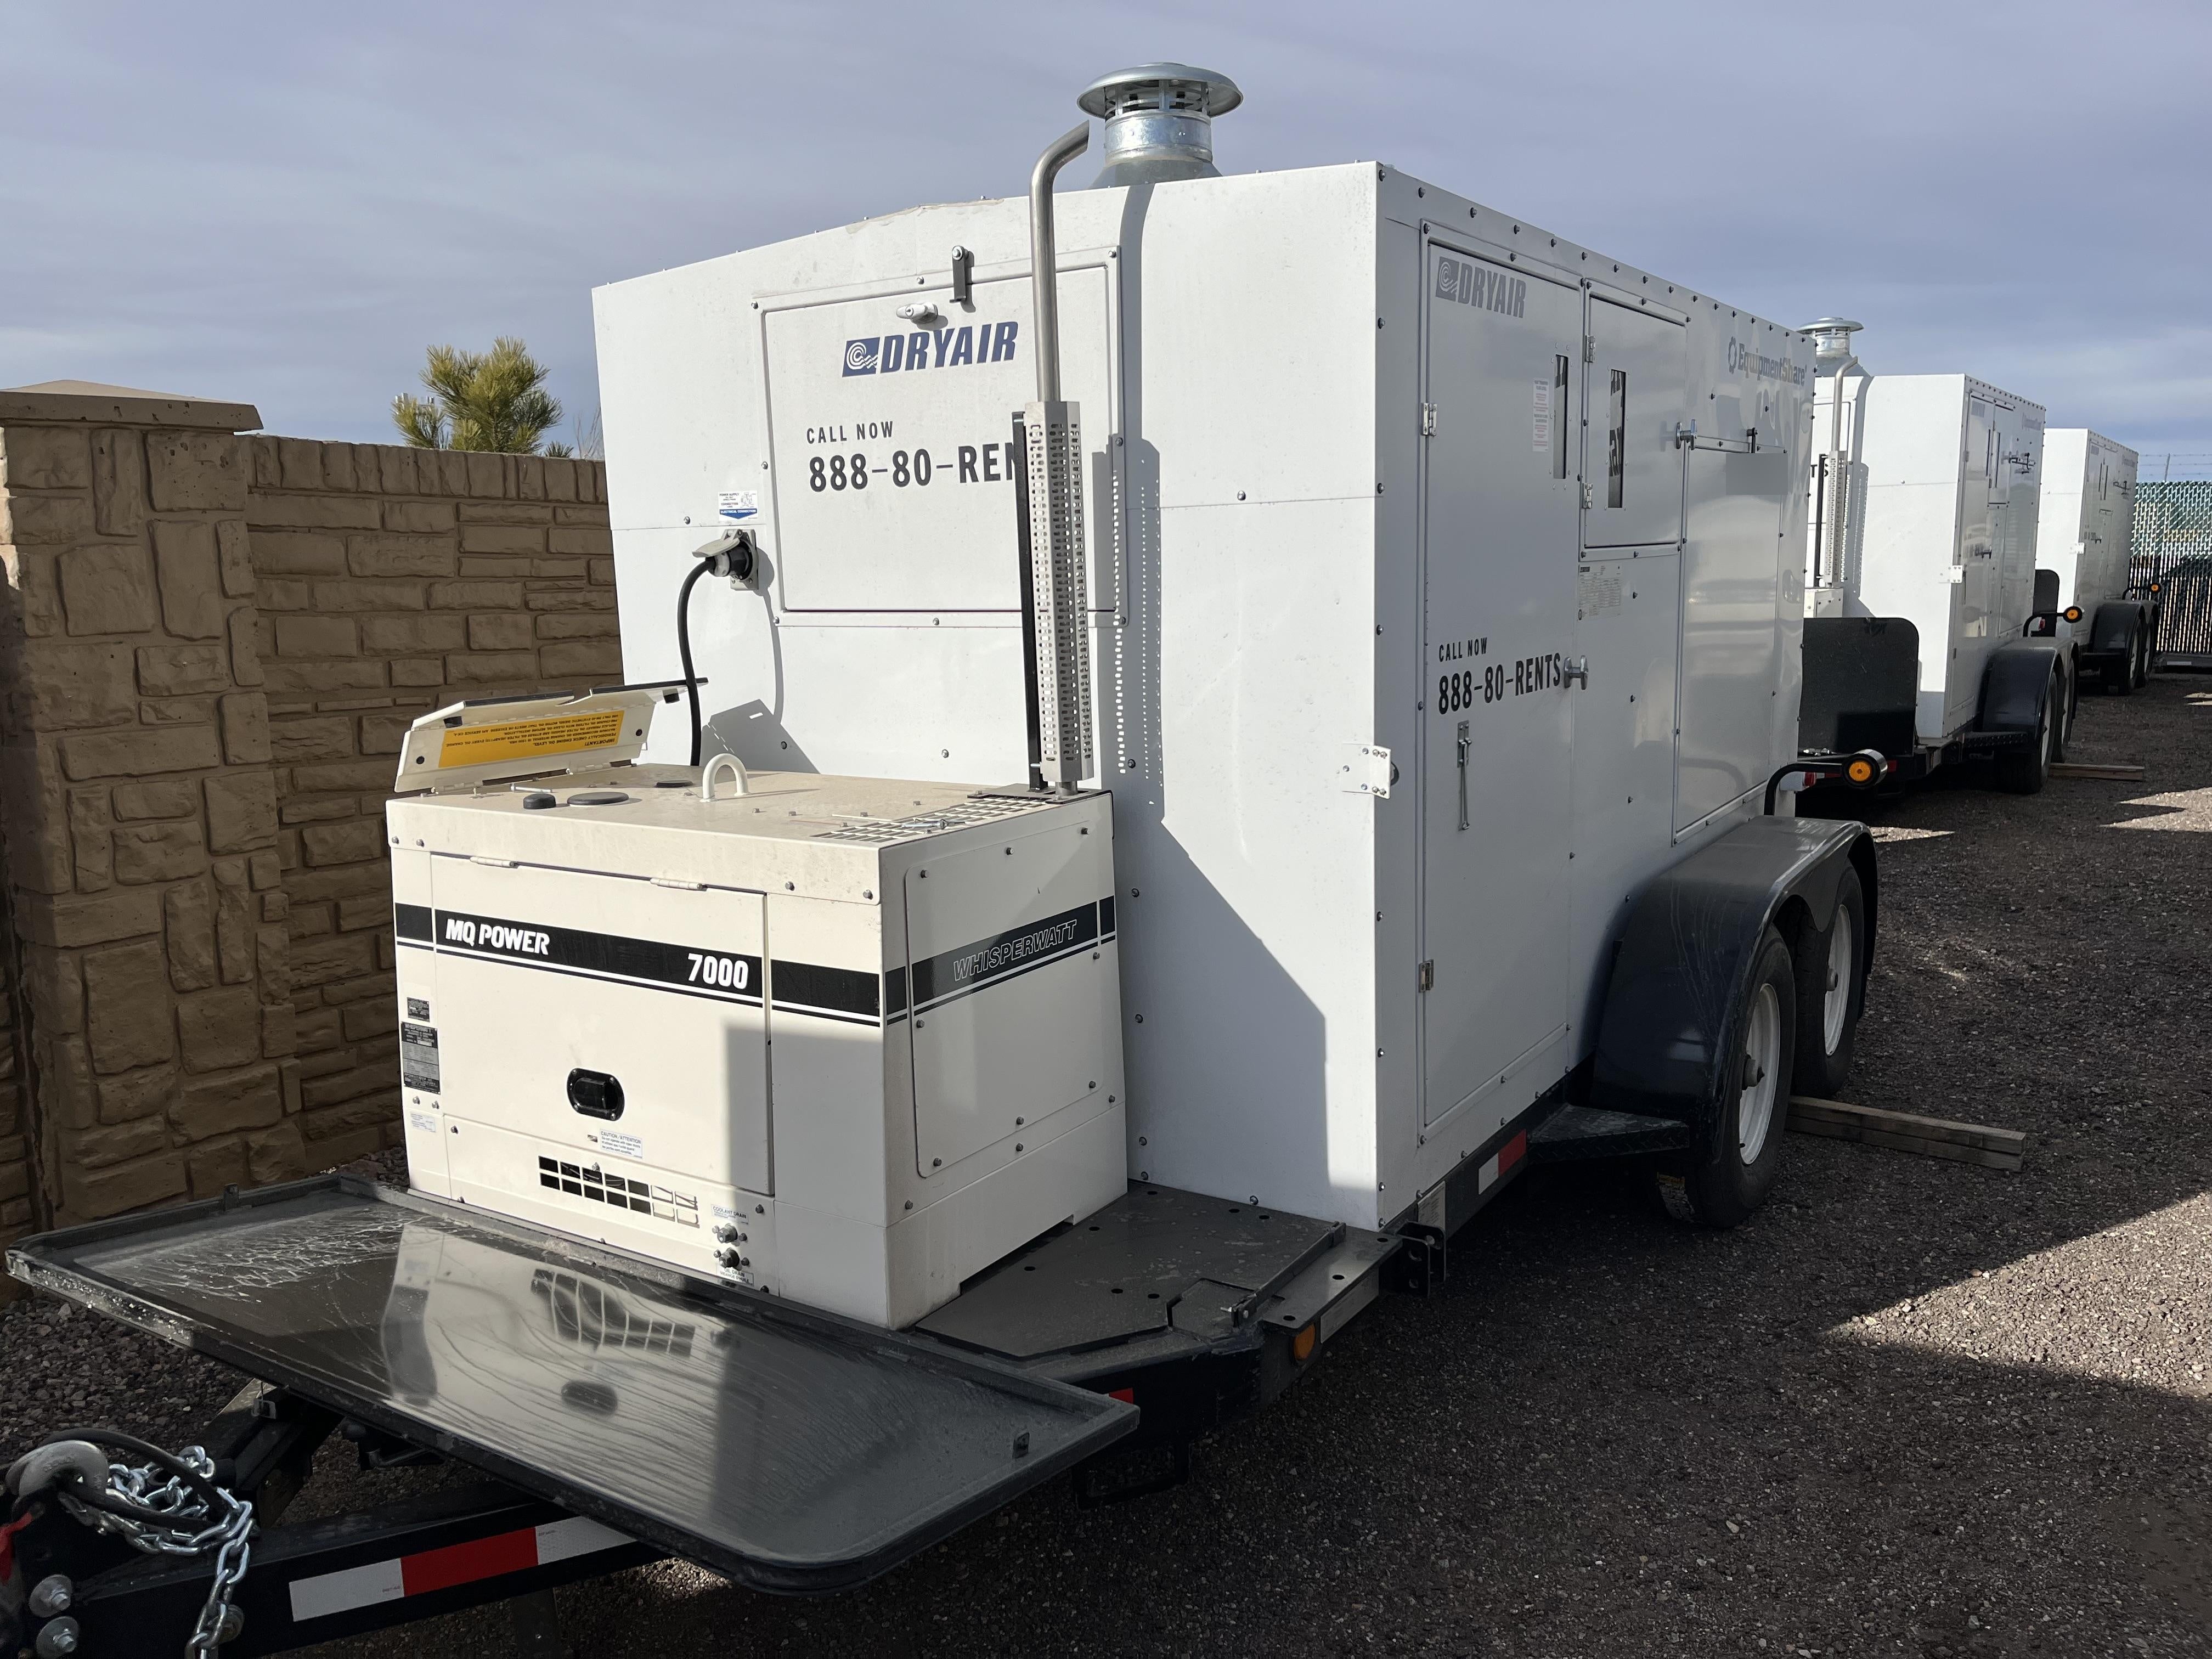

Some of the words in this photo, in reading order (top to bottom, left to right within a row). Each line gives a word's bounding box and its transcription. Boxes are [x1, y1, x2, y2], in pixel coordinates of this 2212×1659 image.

[1458, 263, 1526, 318] DRYAIR
[880, 321, 1018, 374] DRYAIR
[806, 426, 847, 444] CALL
[856, 421, 893, 440] NOW
[1439, 641, 1463, 662] CALL
[1468, 637, 1487, 657] NOW
[1439, 652, 1560, 714] 888-80-RENTS
[445, 919, 476, 946] MQ
[478, 924, 550, 955] POWER
[953, 919, 1077, 981] WHISPERWATT
[688, 953, 748, 989] 7000
[713, 1206, 732, 1215] COOLANT
